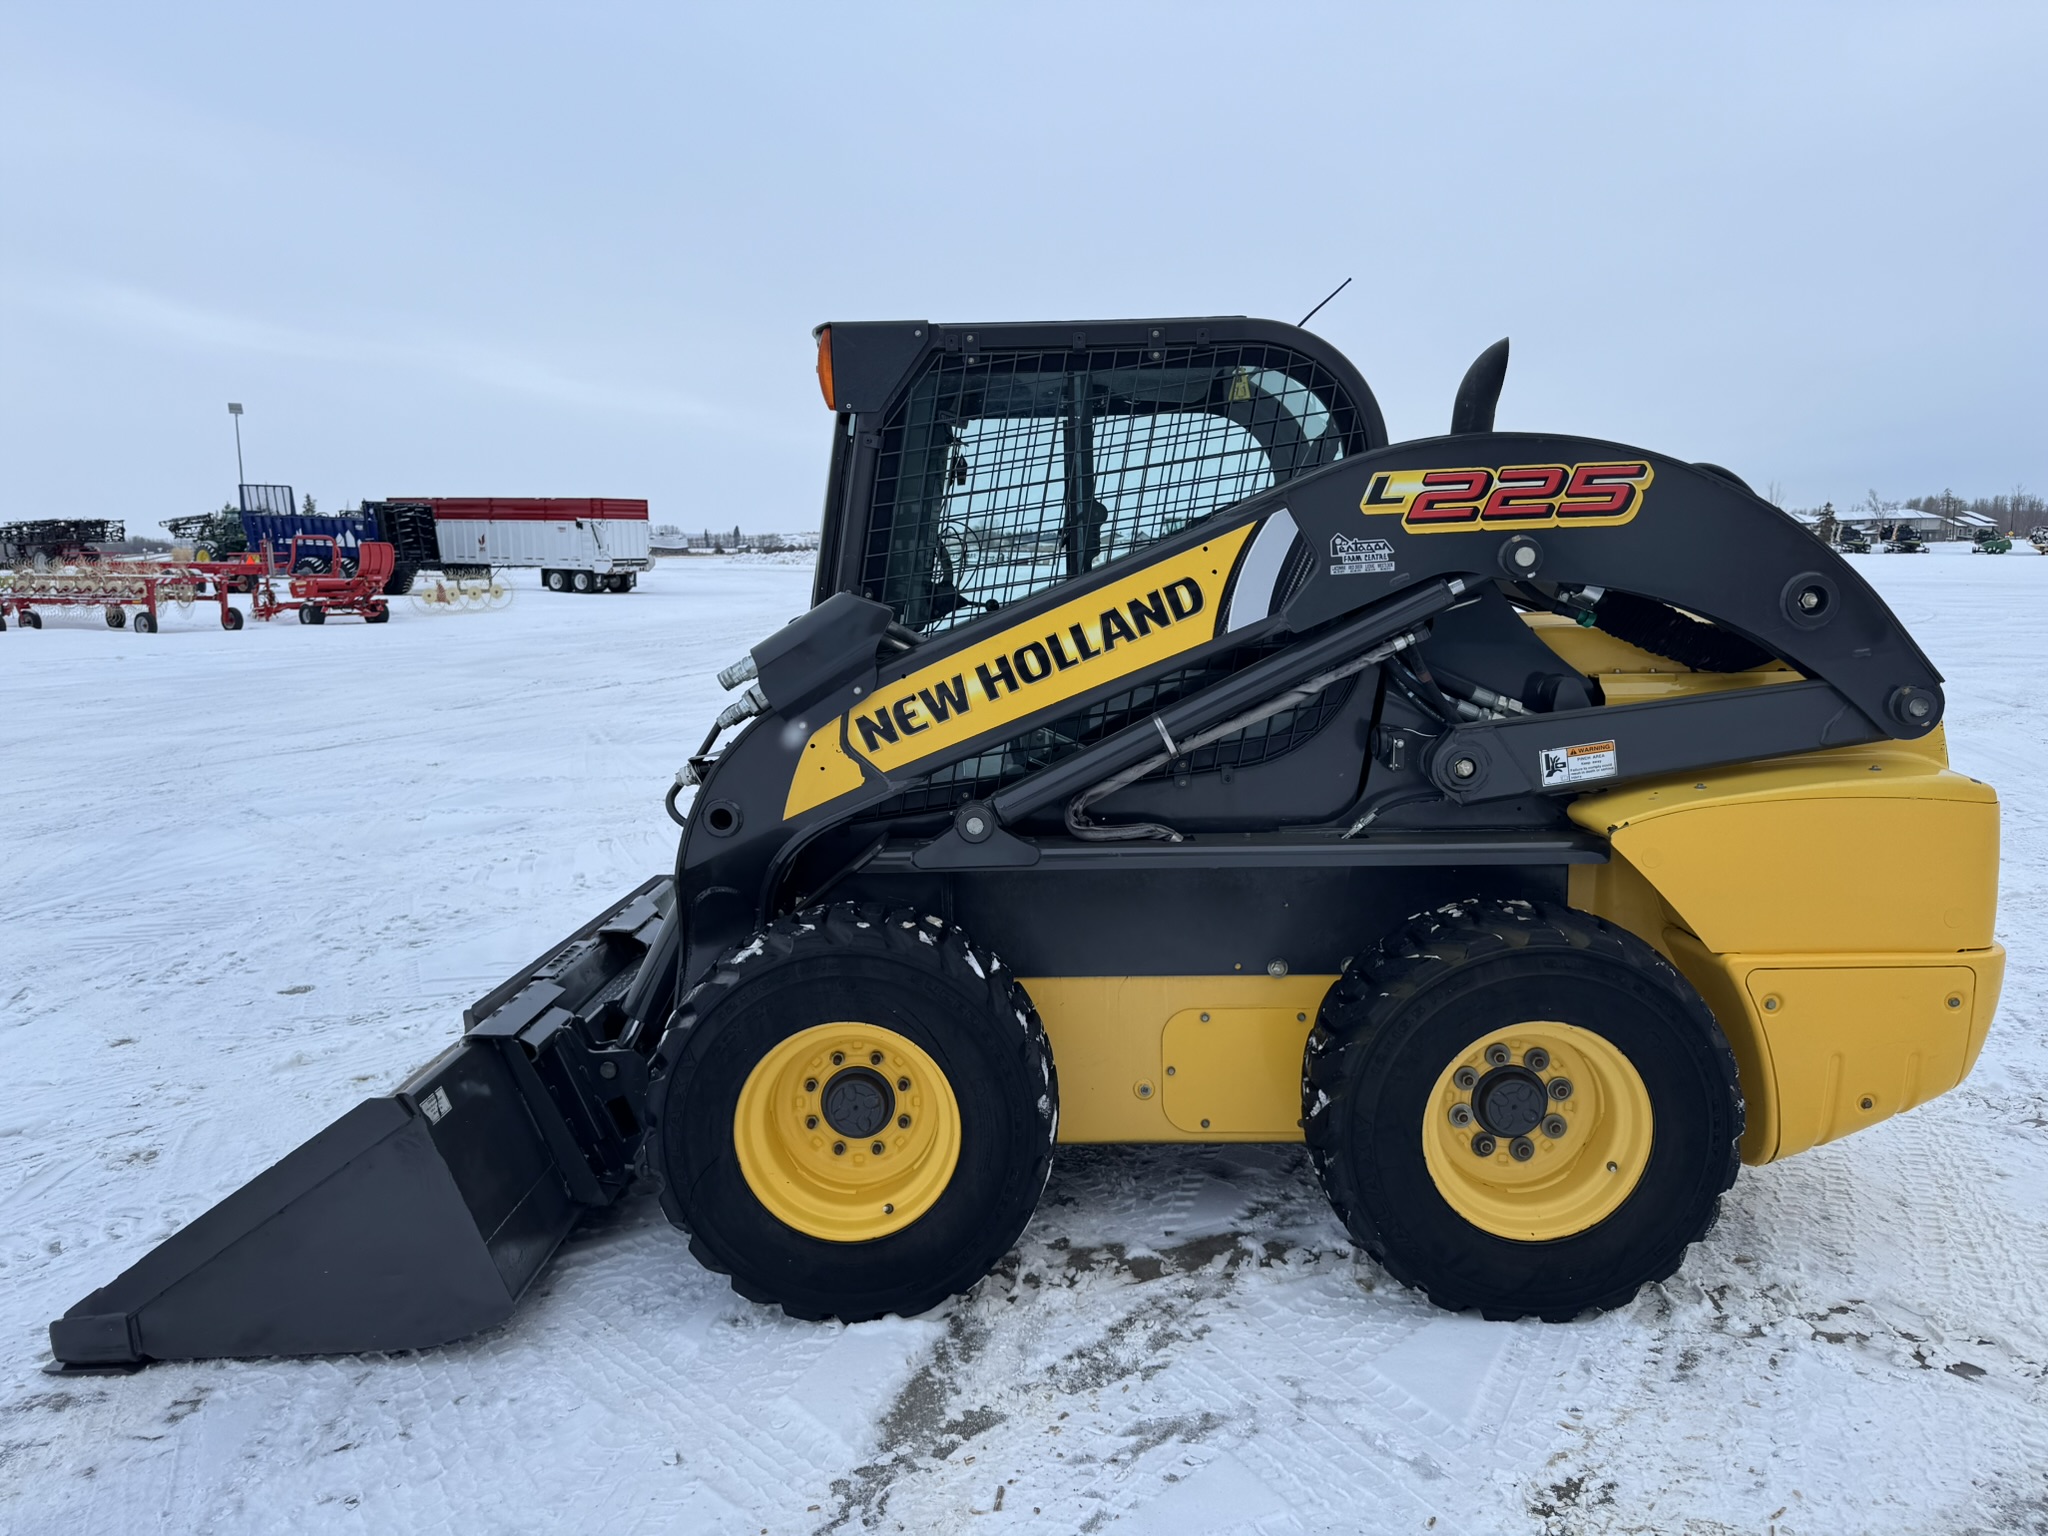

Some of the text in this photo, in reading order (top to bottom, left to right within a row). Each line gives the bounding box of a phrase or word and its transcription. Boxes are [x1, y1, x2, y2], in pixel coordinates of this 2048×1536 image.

[1361, 462, 1653, 532] L225
[1364, 553, 1387, 561] CENTRE
[854, 576, 1205, 753] NEW HOLLAND
[1578, 744, 1610, 753] WARNING
